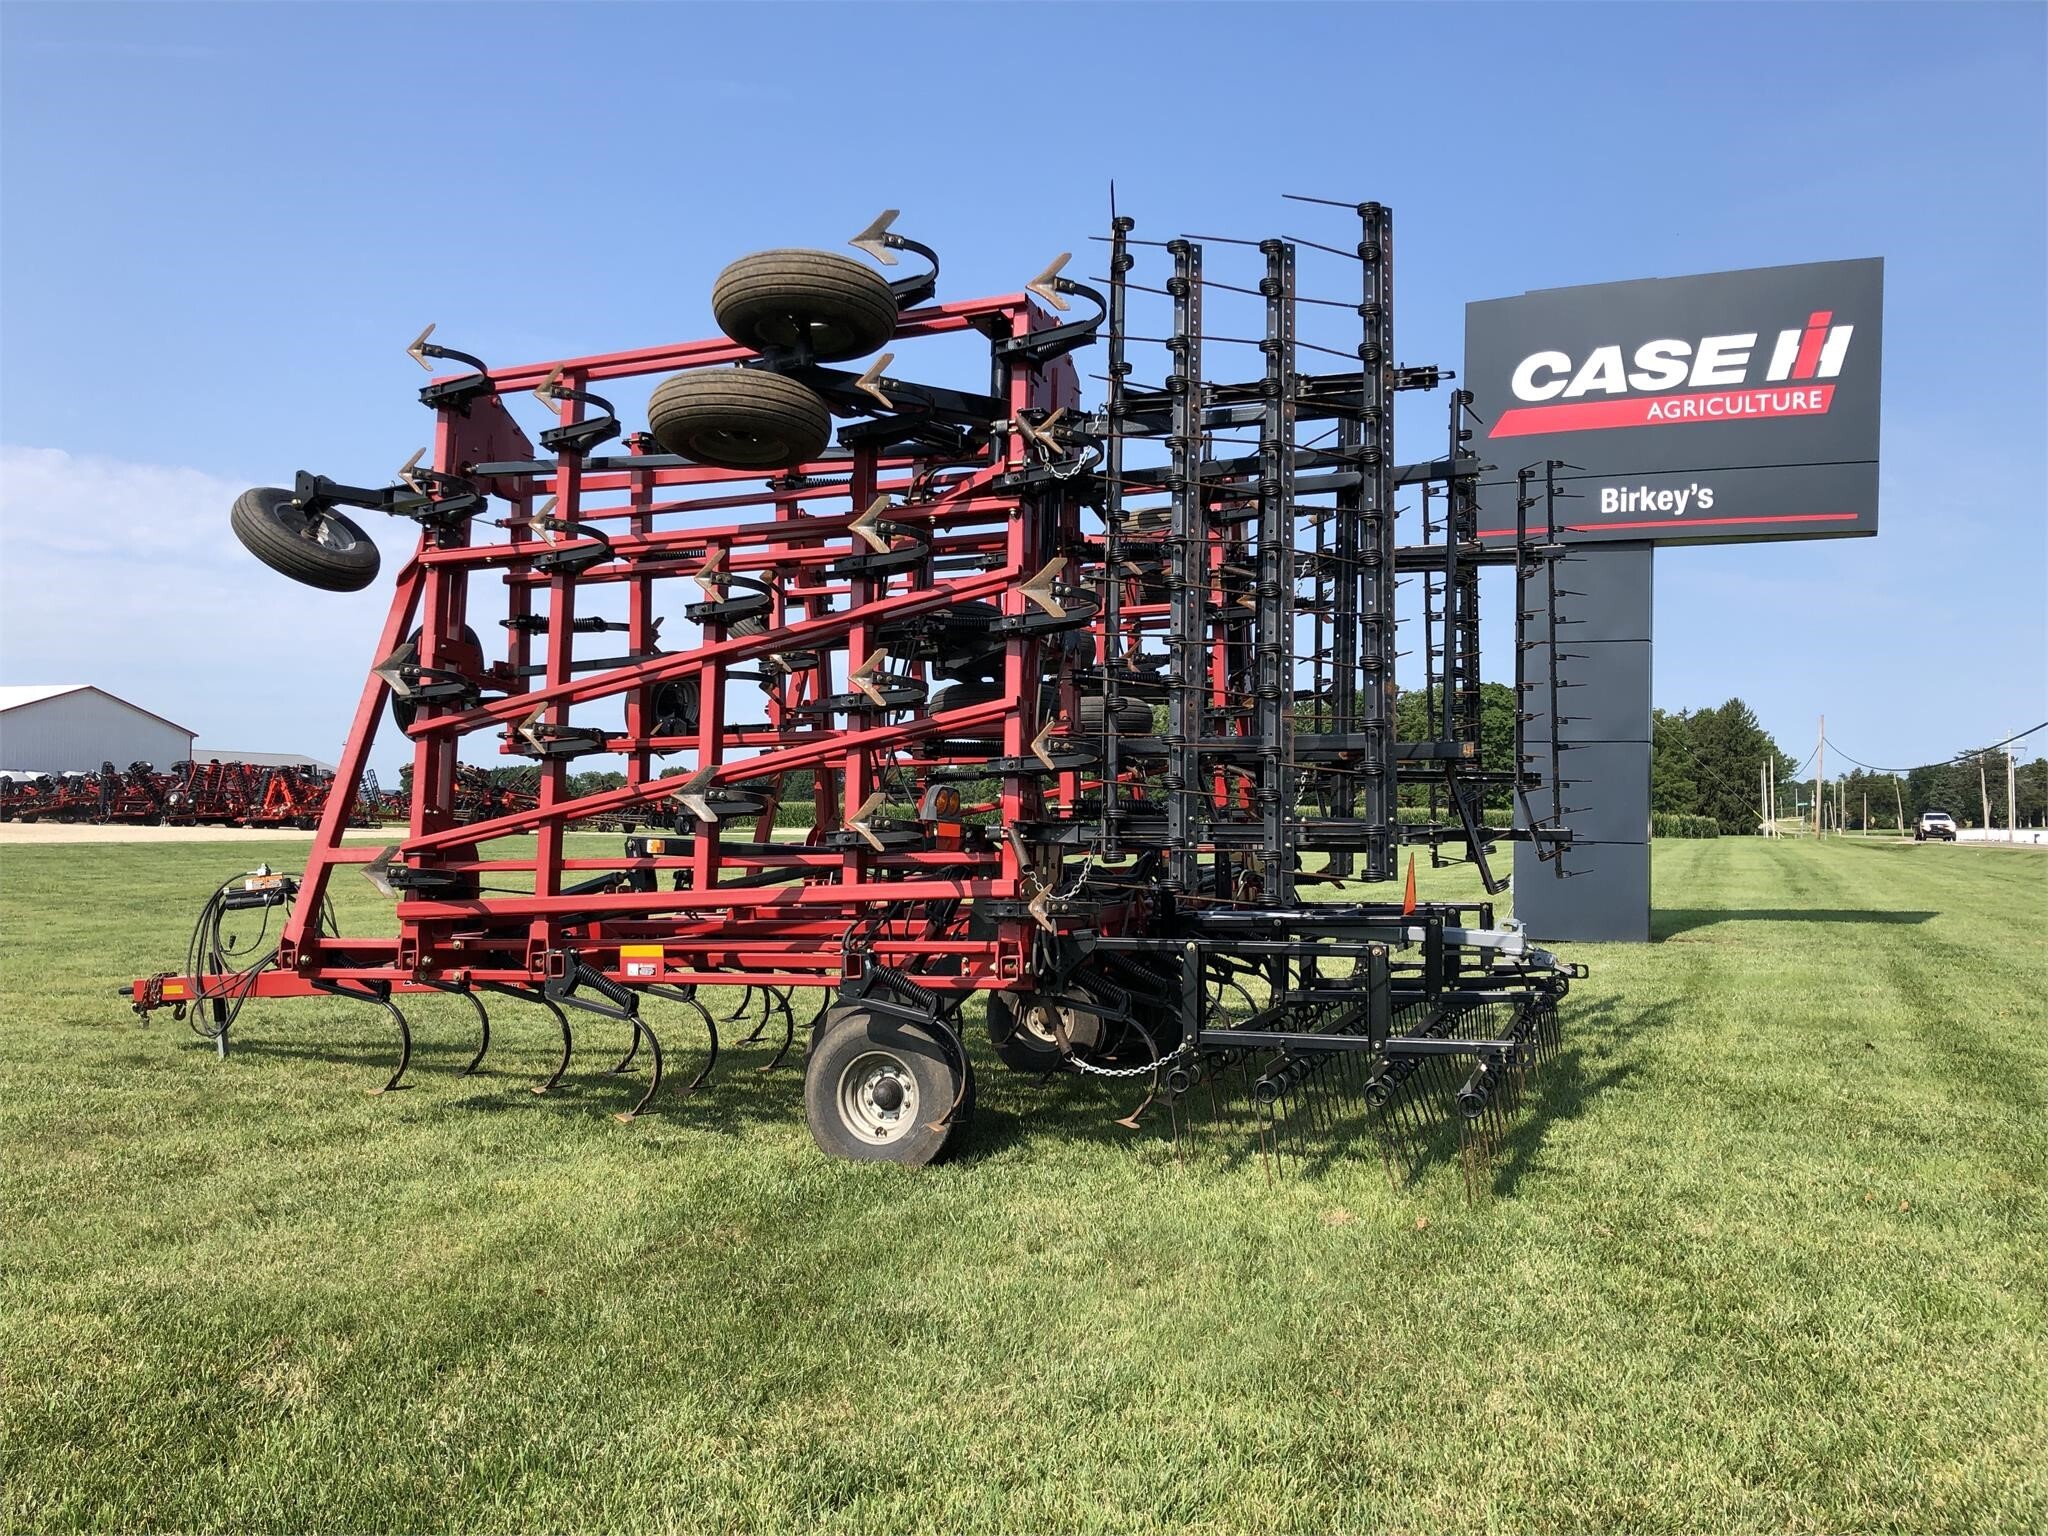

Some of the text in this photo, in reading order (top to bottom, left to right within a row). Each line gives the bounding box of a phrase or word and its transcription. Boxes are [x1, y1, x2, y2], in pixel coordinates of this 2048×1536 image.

[1511, 333, 1758, 401] CASE
[1647, 390, 1822, 421] AGRICULTURE
[1600, 483, 1714, 516] Birkey's
